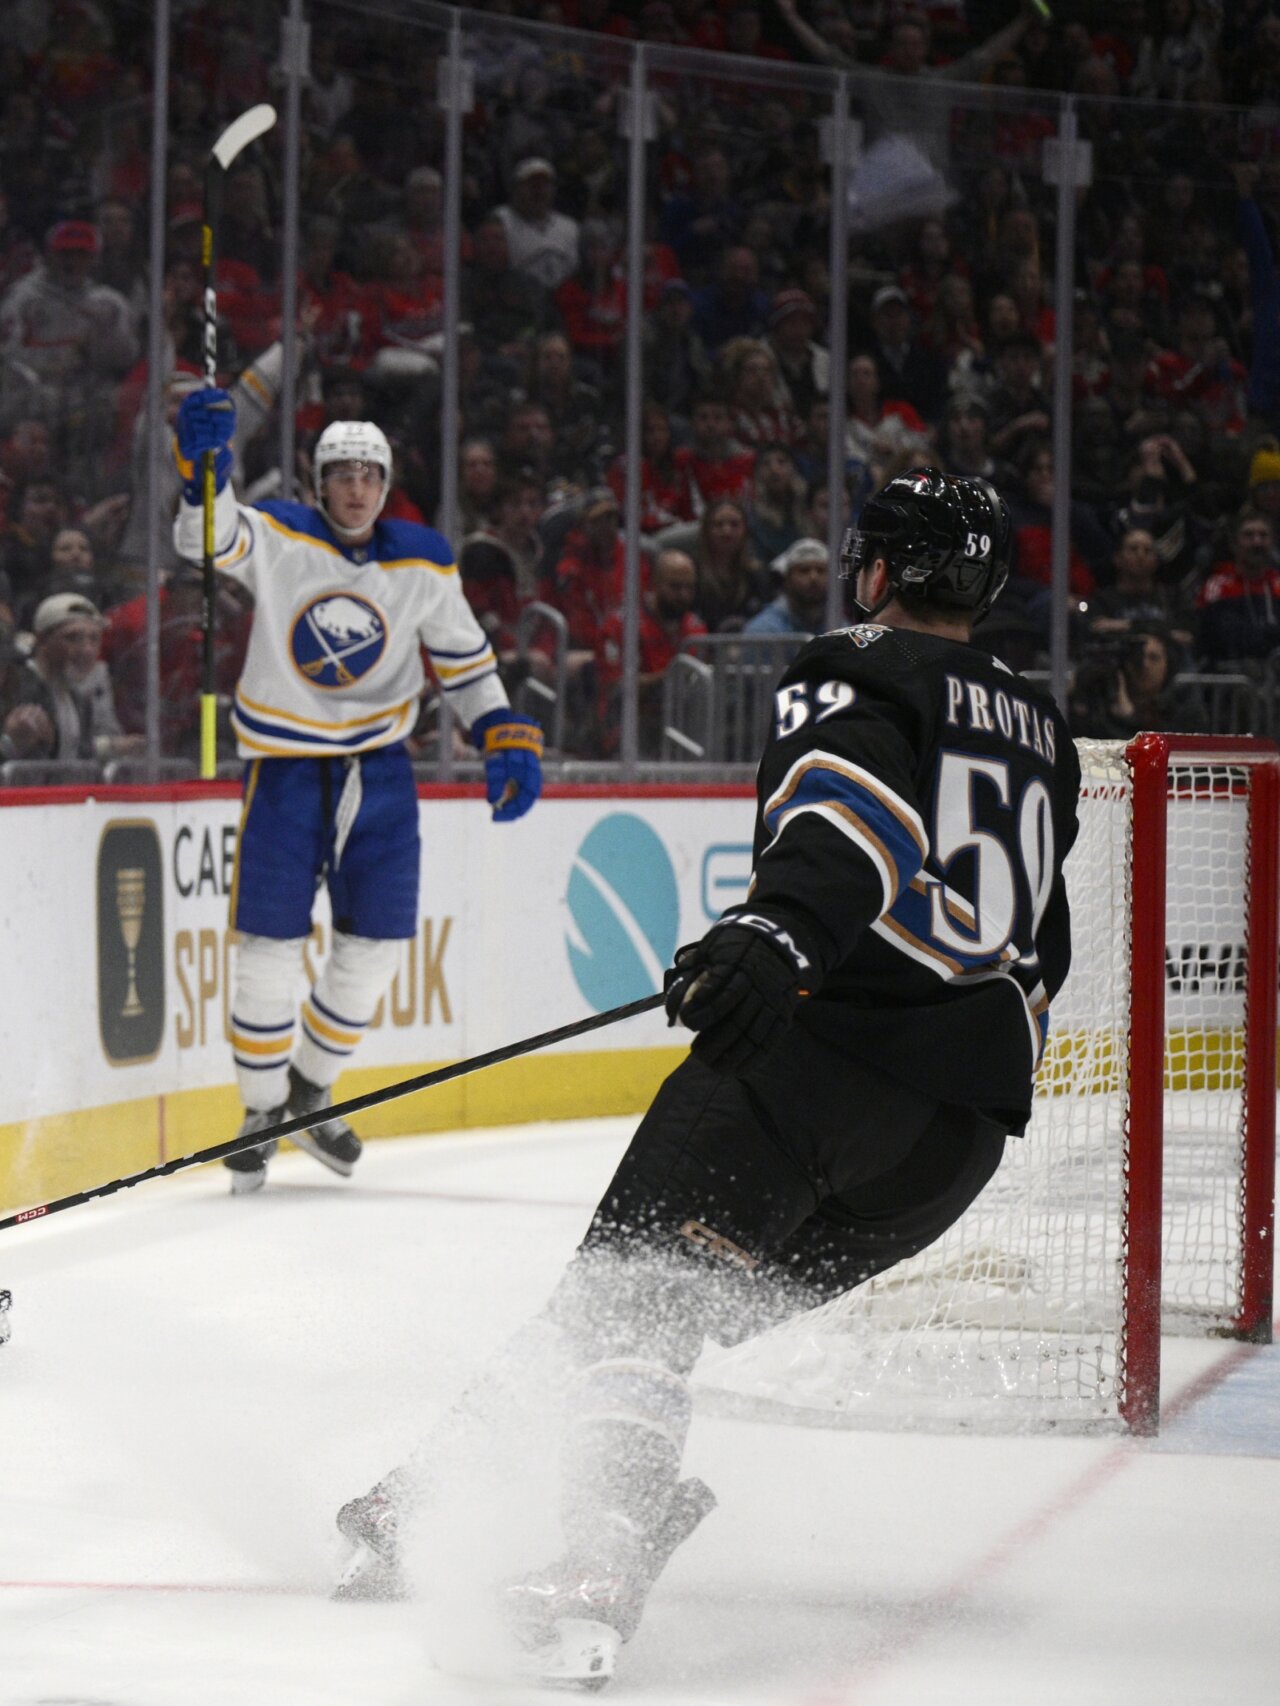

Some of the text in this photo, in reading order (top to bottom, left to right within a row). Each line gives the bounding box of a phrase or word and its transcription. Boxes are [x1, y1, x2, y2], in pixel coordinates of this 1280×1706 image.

[964, 532, 991, 558] 59
[775, 680, 856, 741] 59
[945, 674, 1056, 767] PROTAS
[928, 748, 1056, 967] 59
[174, 916, 453, 1051] SPSOK
[17, 1206, 48, 1223] CCM
